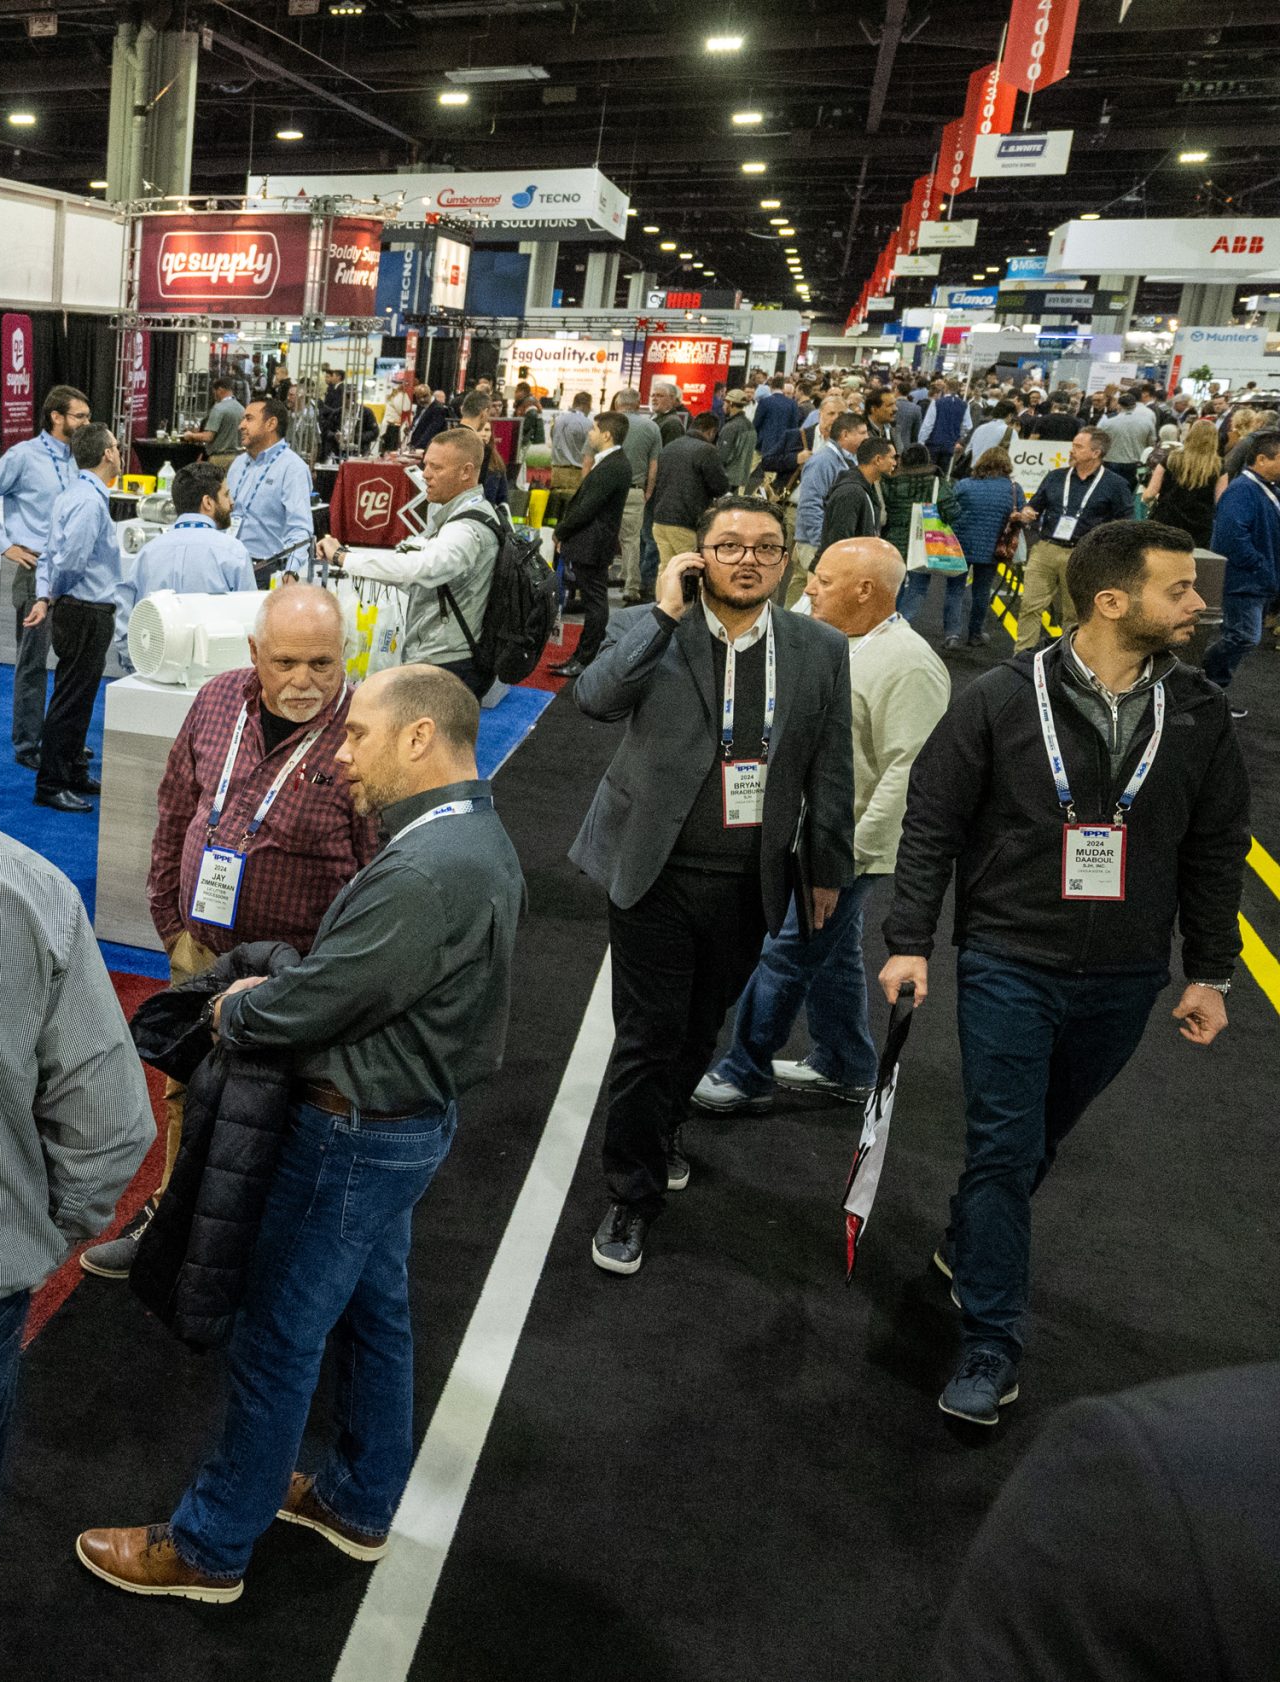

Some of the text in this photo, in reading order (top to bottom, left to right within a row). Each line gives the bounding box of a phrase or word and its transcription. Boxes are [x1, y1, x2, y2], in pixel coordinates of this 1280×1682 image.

[436, 188, 502, 208] Cumberland
[538, 193, 581, 204] TECNO
[1210, 236, 1264, 254] ABB
[329, 244, 362, 263] Boldly
[335, 262, 368, 286] Future
[400, 248, 414, 312] TECNO
[952, 292, 994, 305] Elanco
[1206, 333, 1259, 342] Munters
[650, 341, 717, 354] ACCURATE
[1013, 451, 1044, 466] dcl
[360, 490, 390, 520] qc
[734, 782, 761, 790] BRYAN
[1081, 830, 1110, 838] IPPE
[1075, 848, 1115, 857] MUDAR
[214, 864, 227, 872] 2024
[211, 872, 226, 882] JAY
[200, 879, 235, 892] ZIMMERMAN
